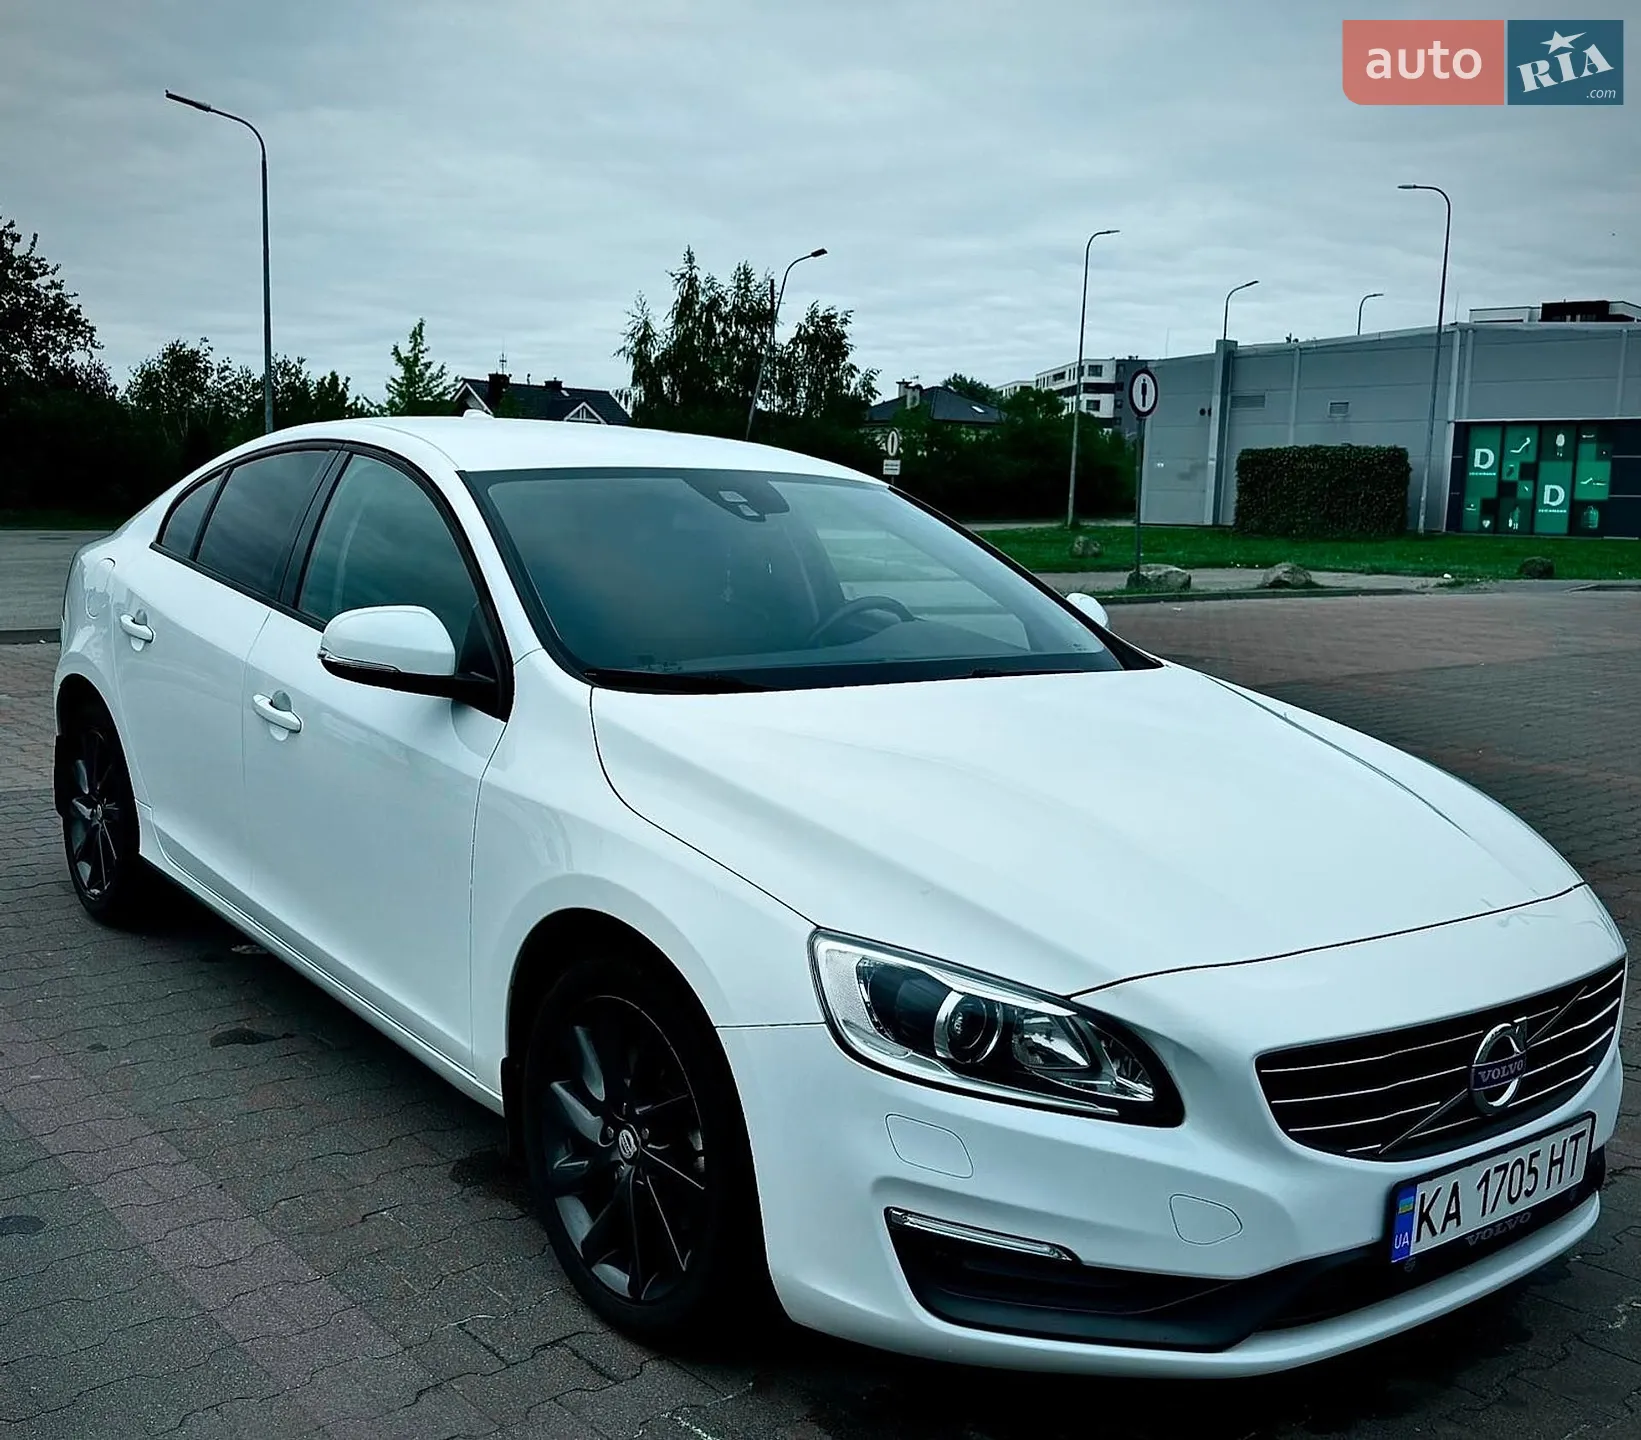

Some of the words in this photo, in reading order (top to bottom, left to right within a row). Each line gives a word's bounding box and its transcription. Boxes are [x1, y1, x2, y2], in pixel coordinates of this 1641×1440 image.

[1474, 448, 1495, 469] D
[1544, 484, 1565, 506] D
[1478, 1060, 1524, 1082] VOLVO
[1415, 1181, 1462, 1243] KA
[1476, 1149, 1541, 1217] 1705
[1546, 1129, 1587, 1190] HT
[1465, 1212, 1532, 1246] VOLVO
[1394, 1232, 1410, 1249] UA
